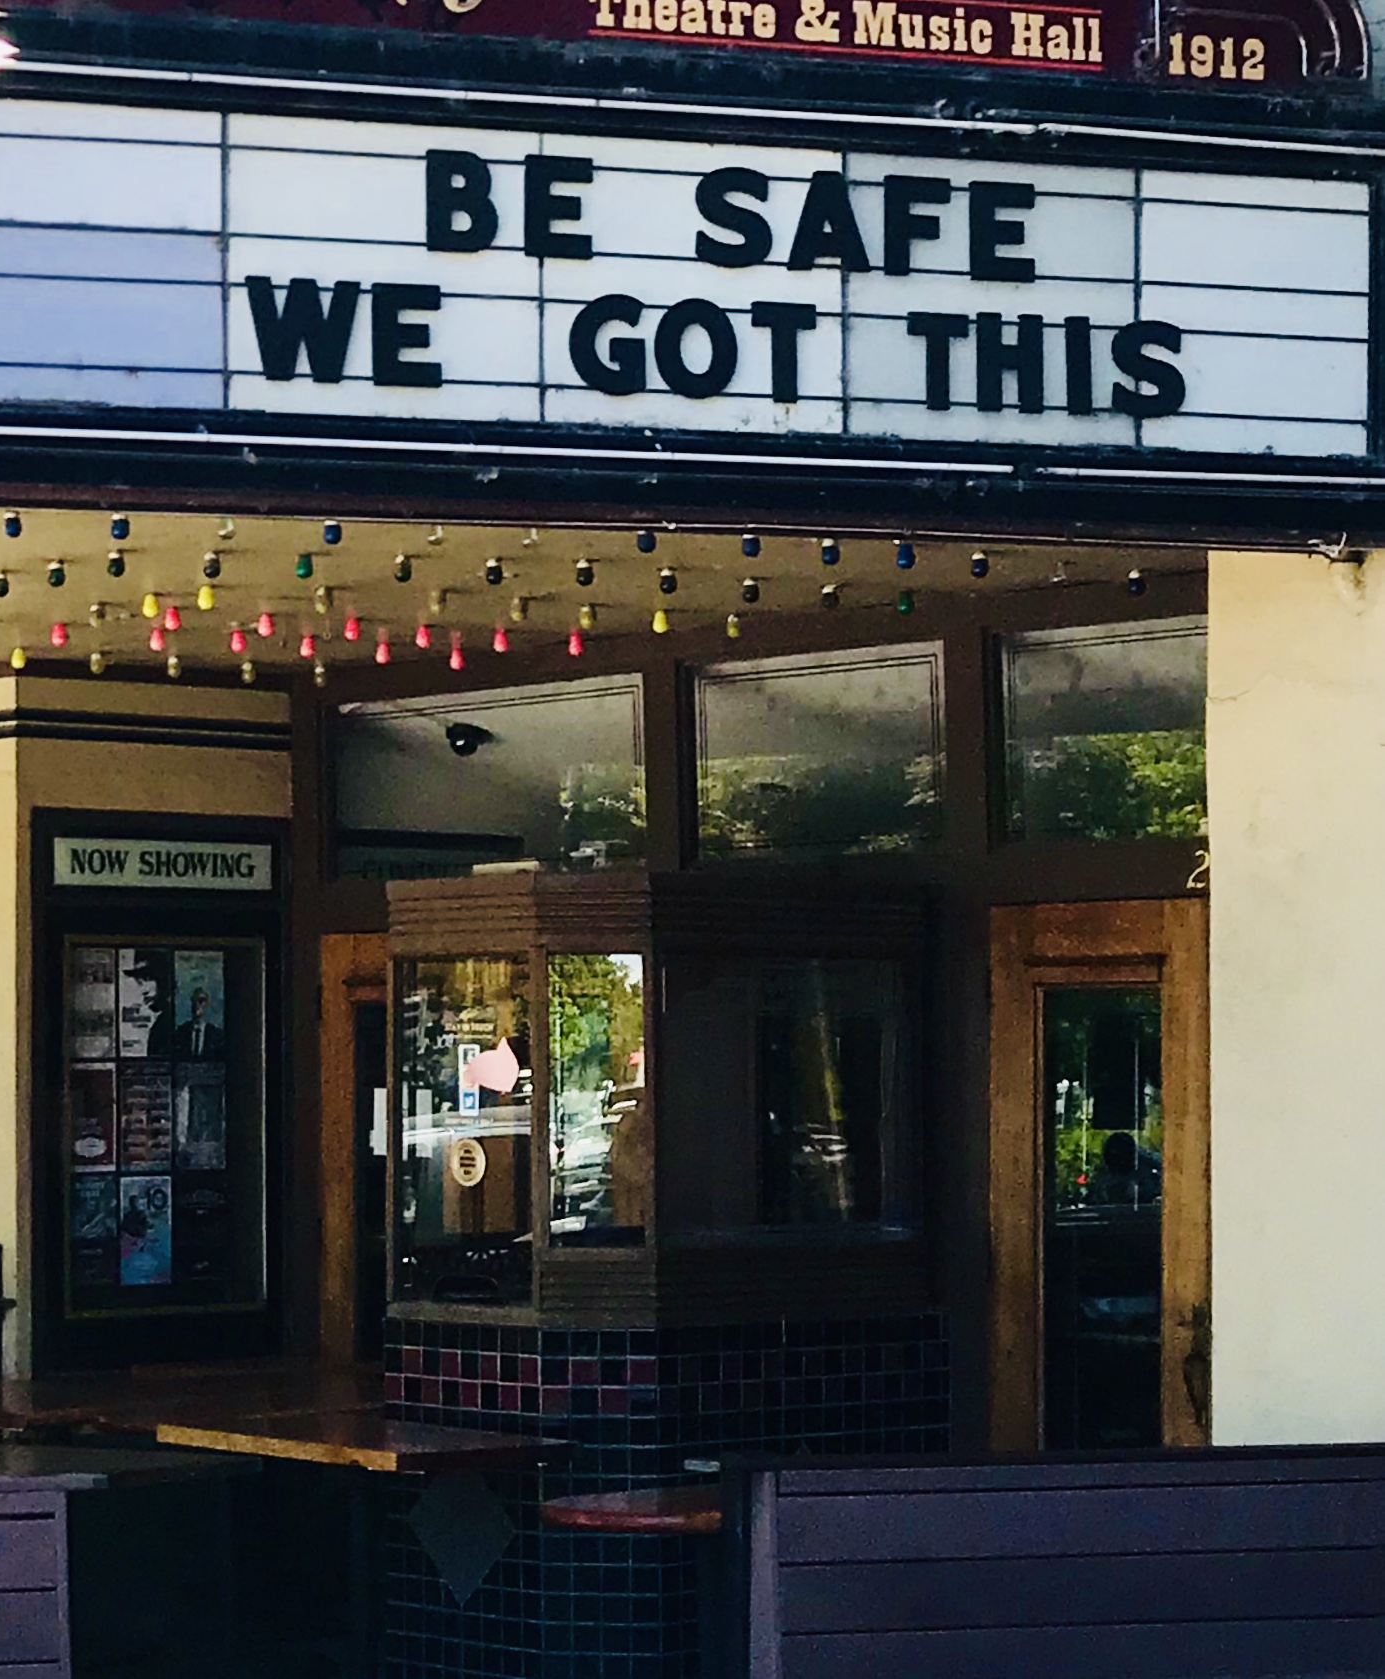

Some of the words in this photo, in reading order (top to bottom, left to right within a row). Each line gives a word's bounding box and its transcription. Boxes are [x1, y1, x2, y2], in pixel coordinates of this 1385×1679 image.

[854, 0, 994, 55] Music
[1011, 11, 1102, 62] Hall
[1168, 32, 1265, 81] 1912
[425, 150, 593, 259] BE
[694, 166, 1035, 283] SAFE
[245, 275, 442, 389] WE
[569, 293, 816, 404] GOT
[907, 311, 1186, 417] THIS
[70, 847, 130, 875] NOW
[139, 850, 256, 879] SHOWING
